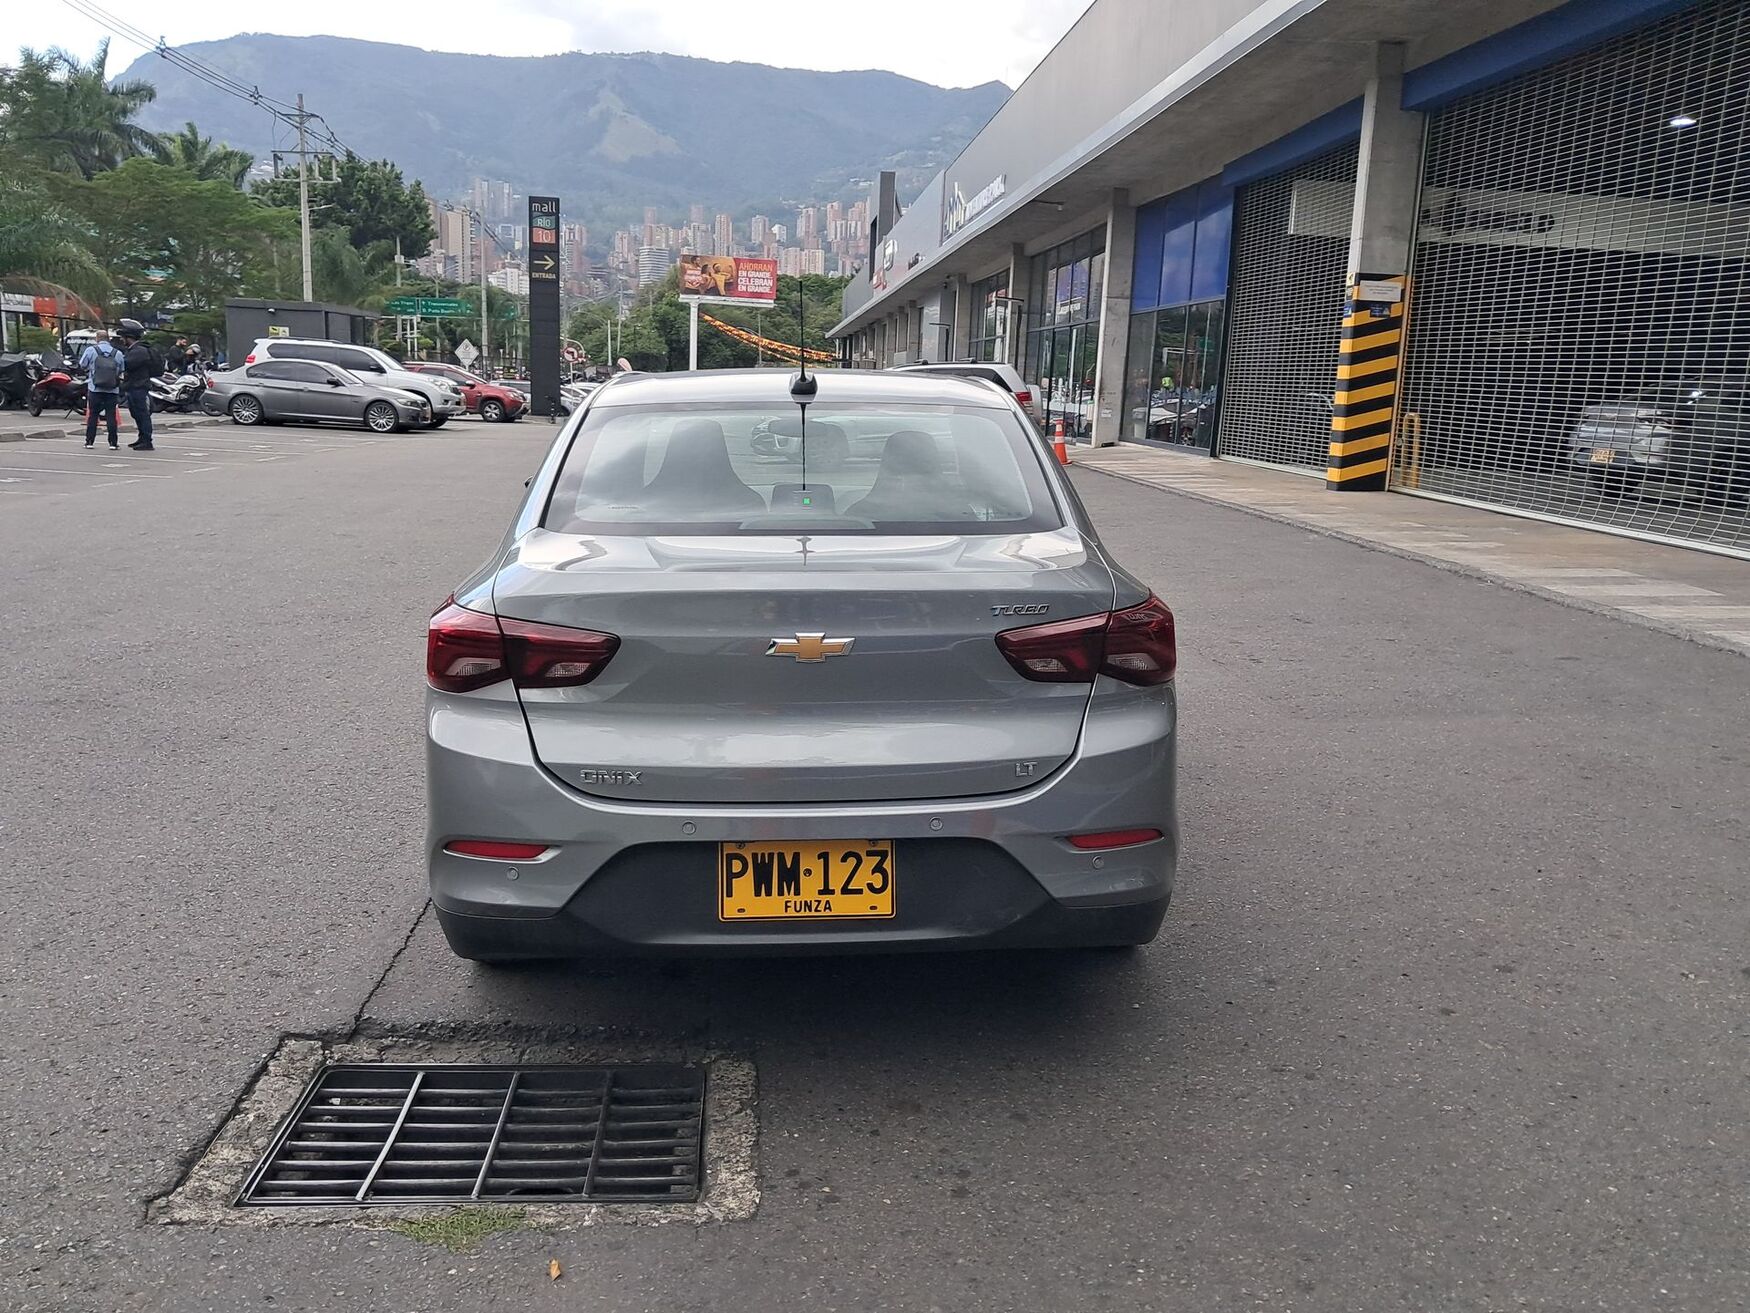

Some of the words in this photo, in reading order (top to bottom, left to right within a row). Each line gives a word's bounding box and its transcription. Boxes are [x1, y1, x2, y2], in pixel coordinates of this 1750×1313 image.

[532, 201, 556, 213] mall
[538, 230, 551, 242] 10
[739, 262, 773, 272] AHORRAN
[532, 271, 557, 279] ENTRADA
[737, 277, 773, 287] CELEBRAN
[991, 603, 1050, 616] TURBO
[1015, 761, 1039, 777] LT
[580, 769, 643, 785] ONIX
[725, 851, 801, 898] PWM
[817, 850, 889, 896] 123
[784, 899, 832, 913] FUNZA
